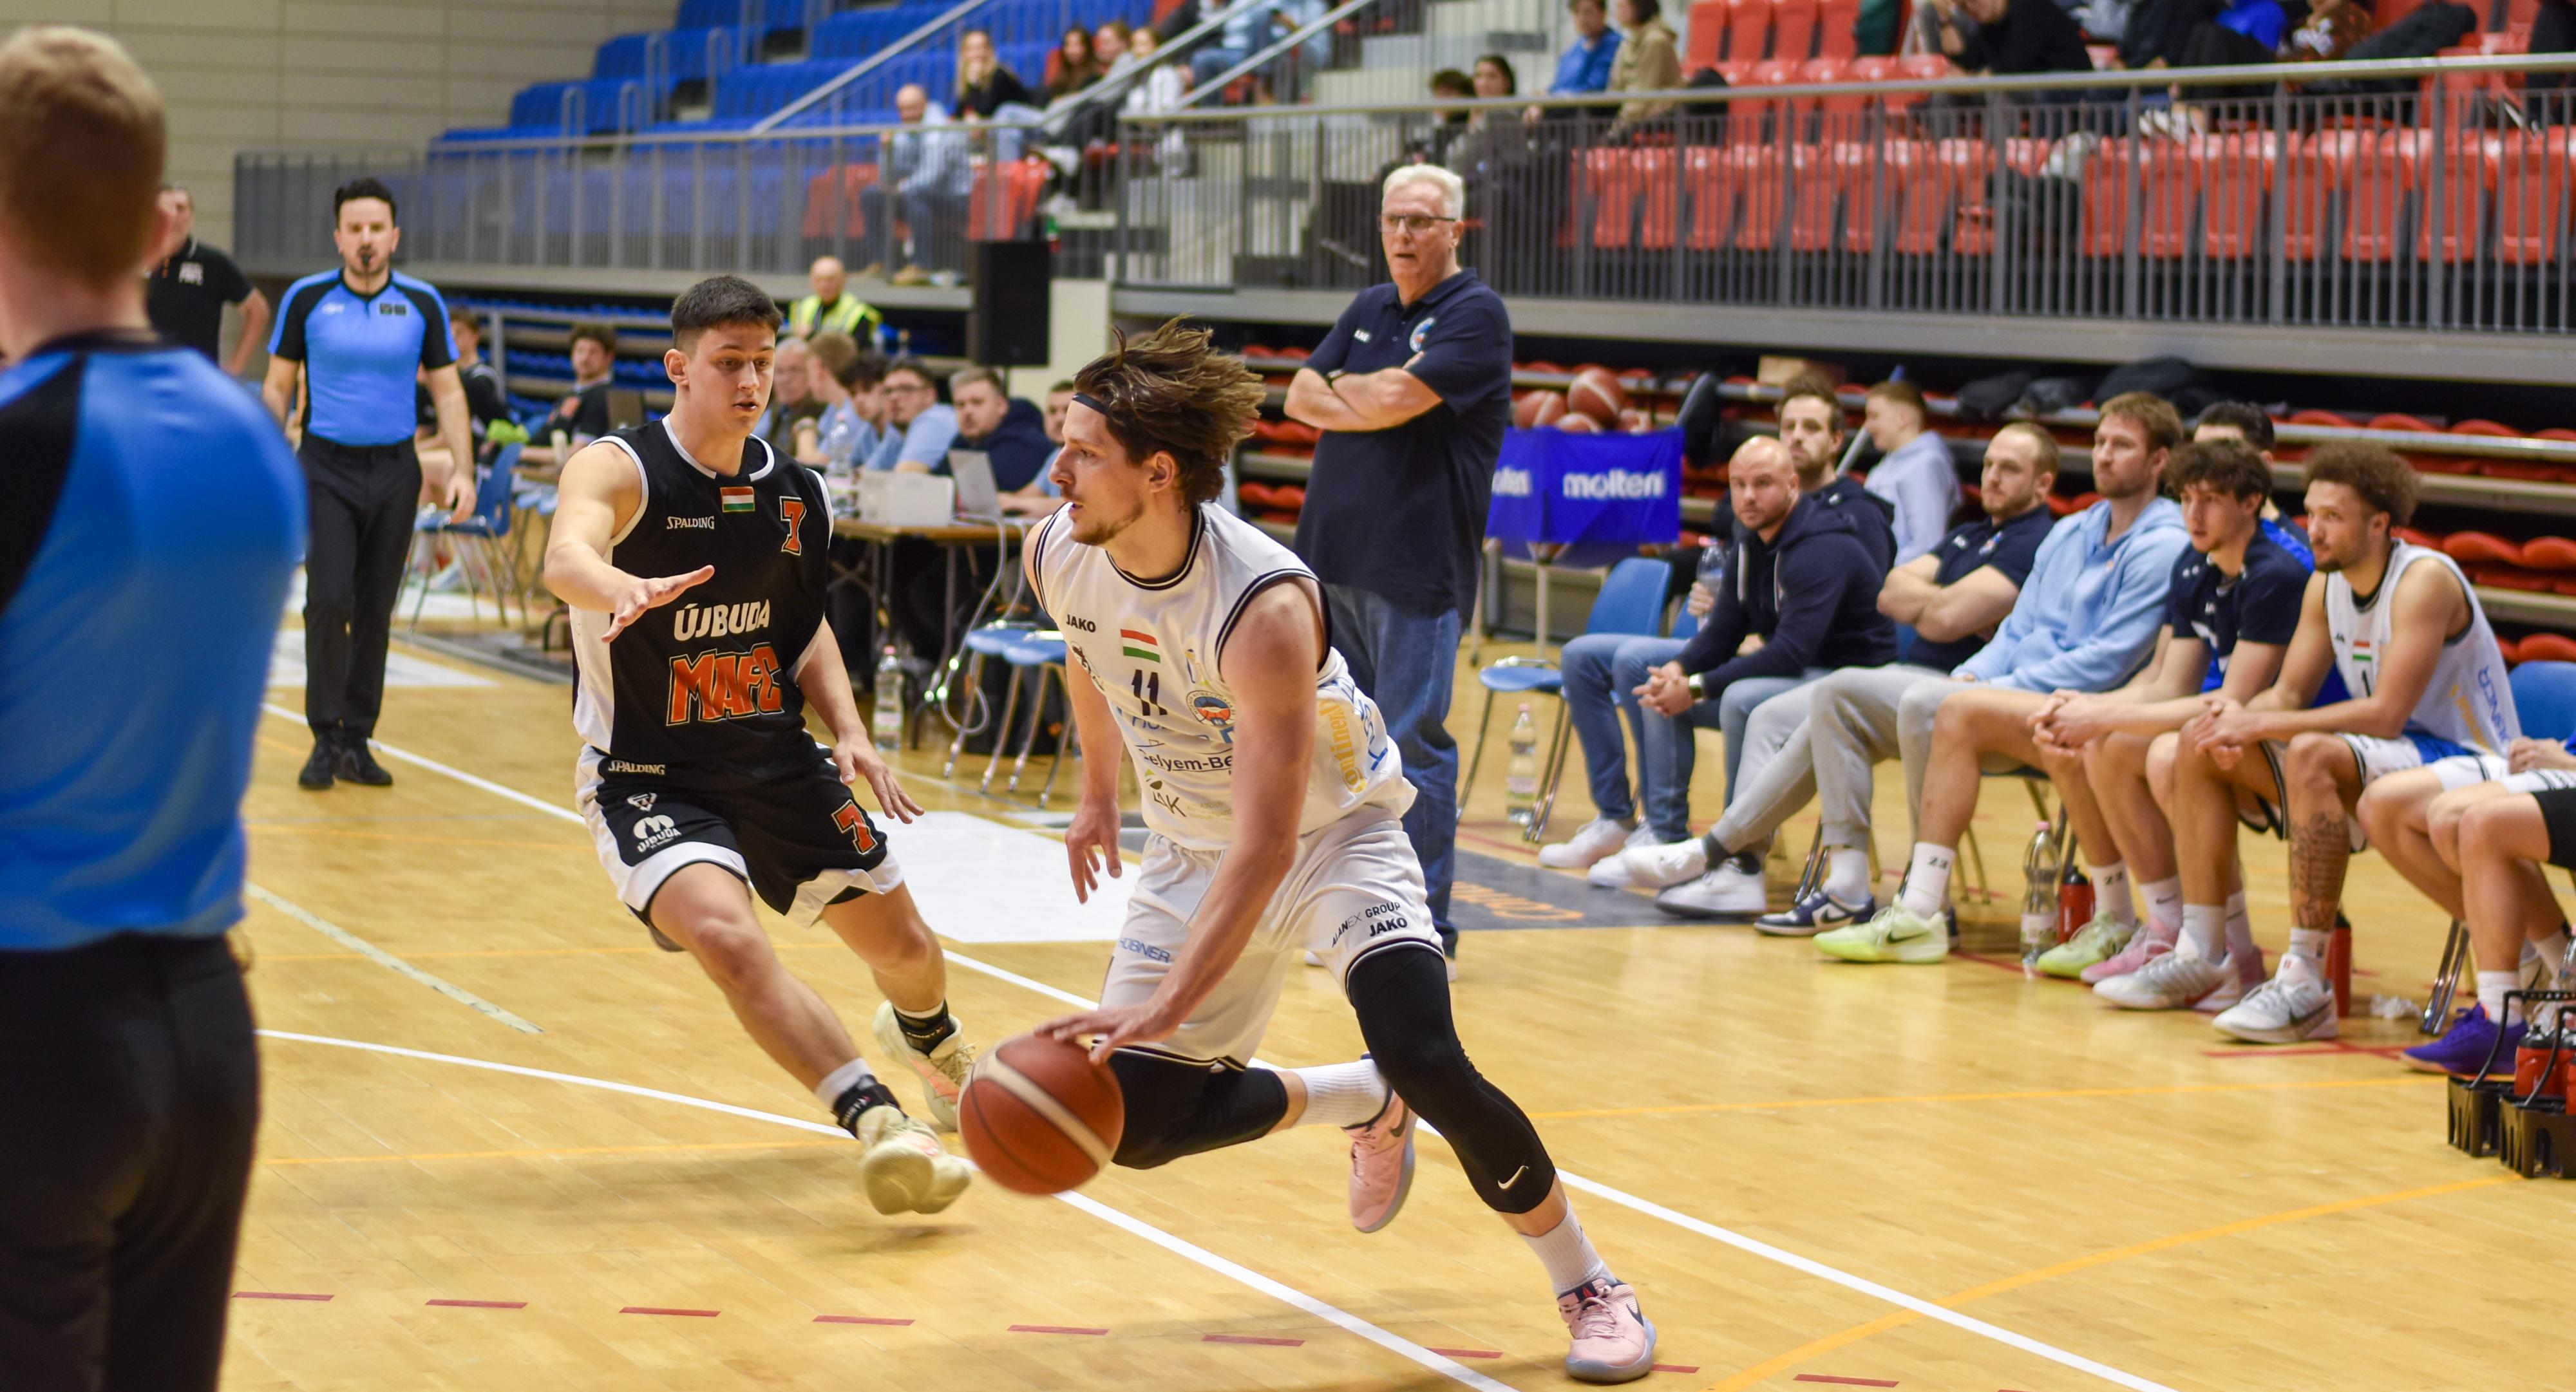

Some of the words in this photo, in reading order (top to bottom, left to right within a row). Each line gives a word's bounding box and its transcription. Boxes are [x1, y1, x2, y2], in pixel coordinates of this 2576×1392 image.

[1562, 469, 1665, 500] molten
[667, 516, 715, 531] SPALDING
[779, 496, 806, 556] 7
[674, 599, 771, 641] ÚJBUDA
[1066, 614, 1097, 633] JAKO
[666, 642, 784, 726] MAFC
[1132, 669, 1168, 716] 11
[608, 760, 665, 775] SPALDING
[831, 799, 878, 855] 7
[1365, 901, 1401, 918] GROUP
[1369, 917, 1408, 937] JAKO
